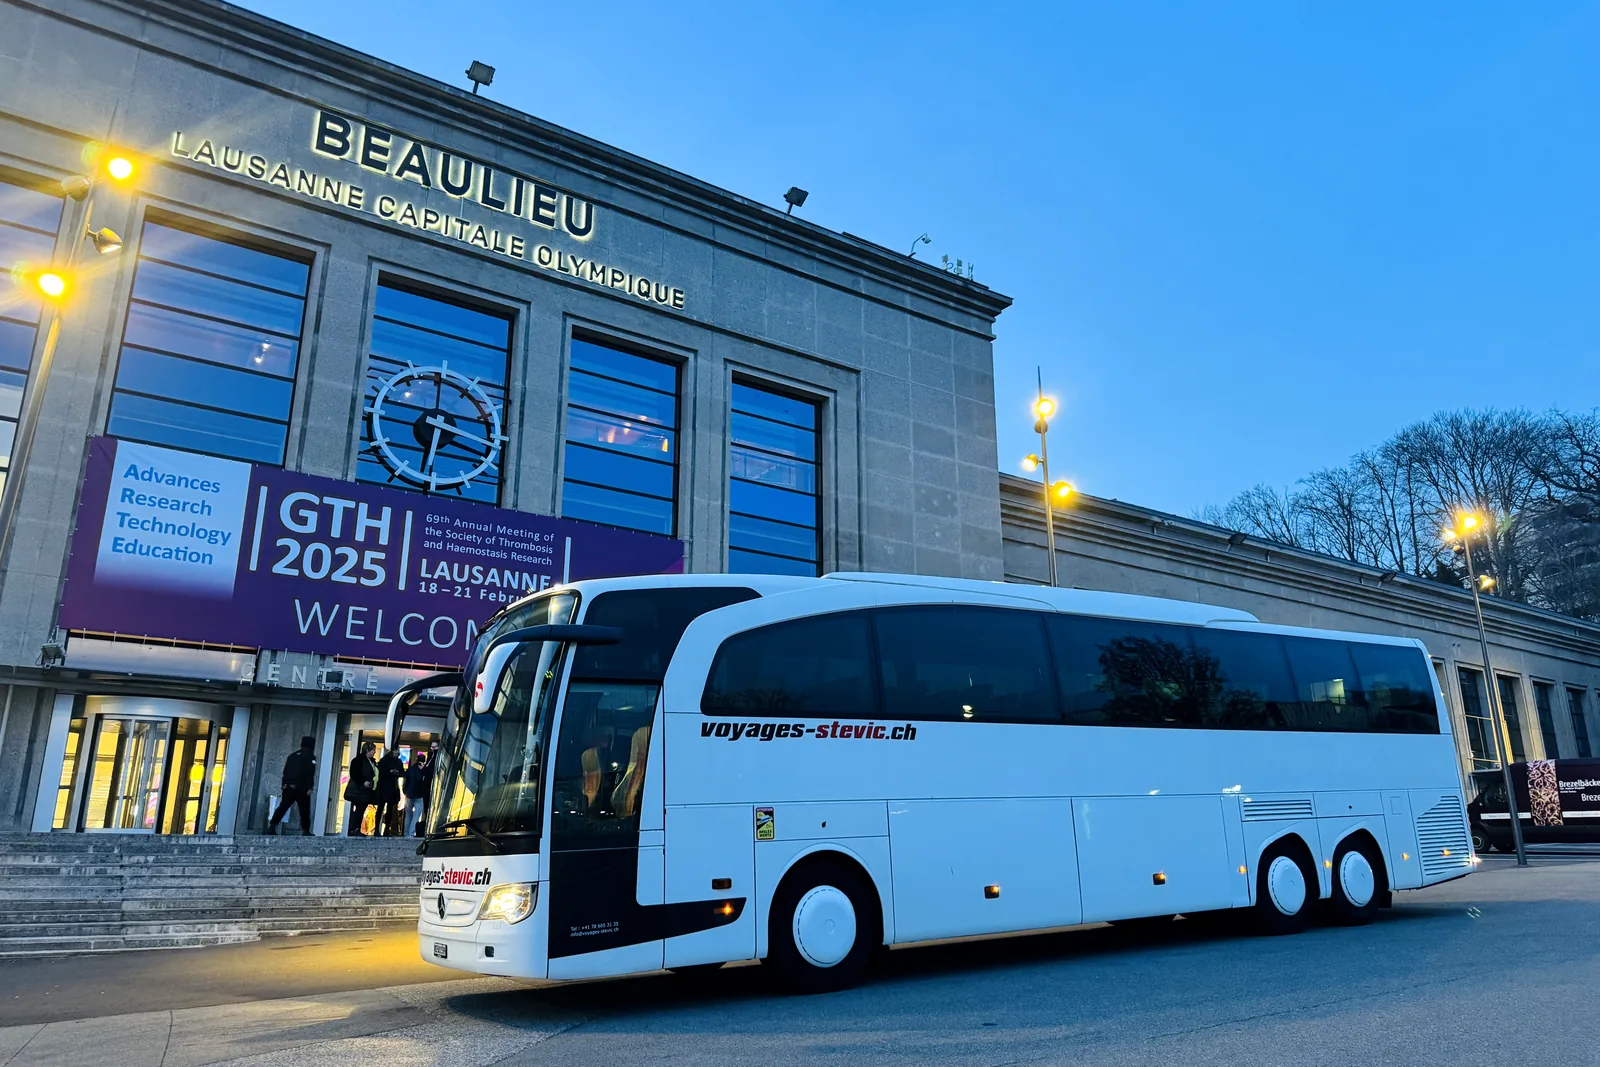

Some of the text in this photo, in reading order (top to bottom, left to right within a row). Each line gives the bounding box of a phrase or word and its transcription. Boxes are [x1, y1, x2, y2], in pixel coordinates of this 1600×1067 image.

[314, 111, 594, 237] BEAULIEU
[171, 131, 685, 310] LAUSANNE CAPITALE OLYMPIQUE
[123, 464, 221, 494] Advances
[120, 488, 212, 516] Research
[116, 512, 232, 546] Technology
[279, 492, 392, 546] GTH
[426, 514, 555, 542] 69th Annual Meeting of
[111, 537, 214, 565] Education
[423, 541, 552, 566] and Haemostasis Research
[425, 526, 553, 554] the Society of Thrombosis
[272, 538, 386, 587] 2025
[420, 559, 551, 592] LAUSANNE
[419, 581, 438, 594] 18
[454, 586, 472, 598] 21
[240, 662, 378, 691] CENTRE
[700, 721, 917, 741] voyages-stevic.ch
